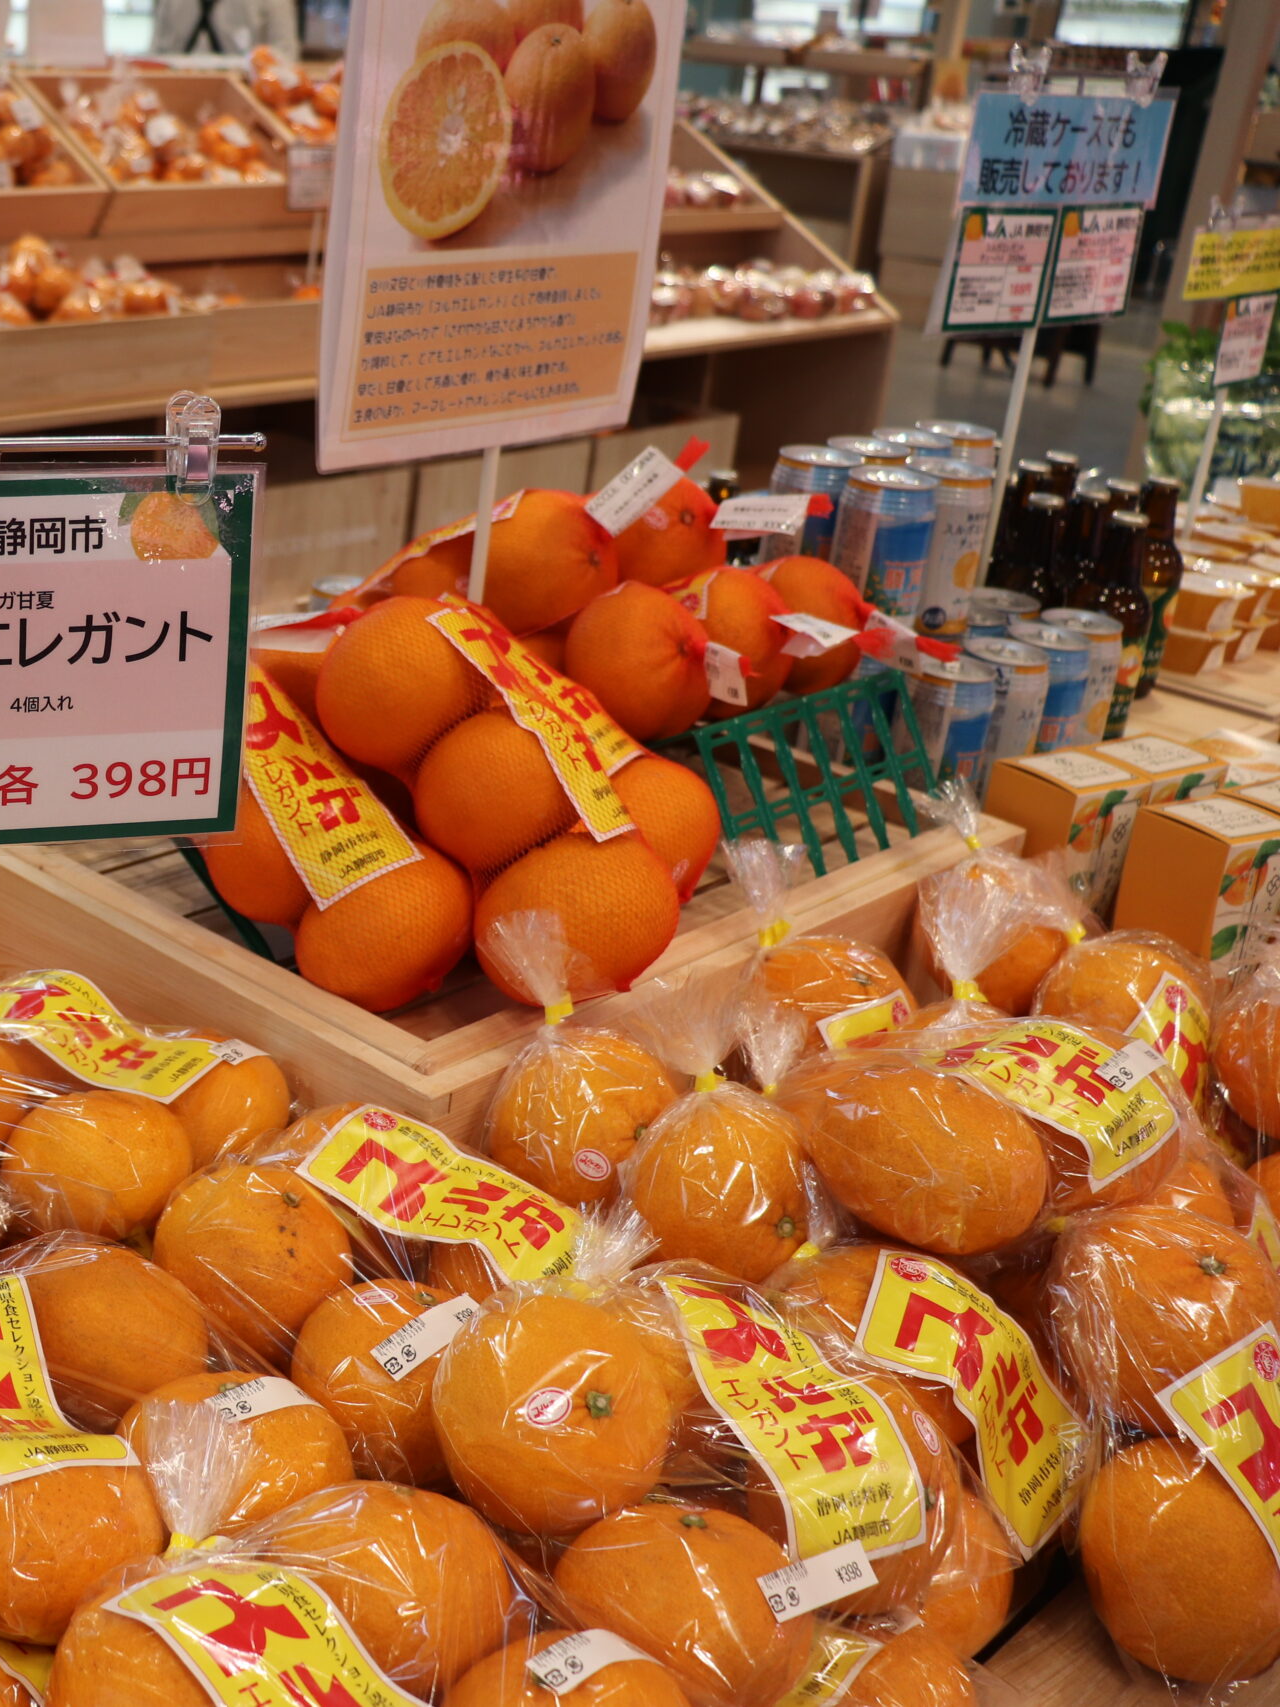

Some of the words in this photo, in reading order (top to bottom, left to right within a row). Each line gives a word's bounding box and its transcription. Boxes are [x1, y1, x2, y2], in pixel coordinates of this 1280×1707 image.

[1004, 109, 1137, 149] 冷蔵ケースでも
[10, 695, 74, 714] 4個入れ
[70, 757, 212, 800] 398円
[335, 1138, 566, 1251] スルガ
[420, 1211, 521, 1260] エレガント
[894, 1292, 1044, 1466] スルガ
[721, 1378, 808, 1471] エレガント
[835, 1561, 862, 1584] ¥398
